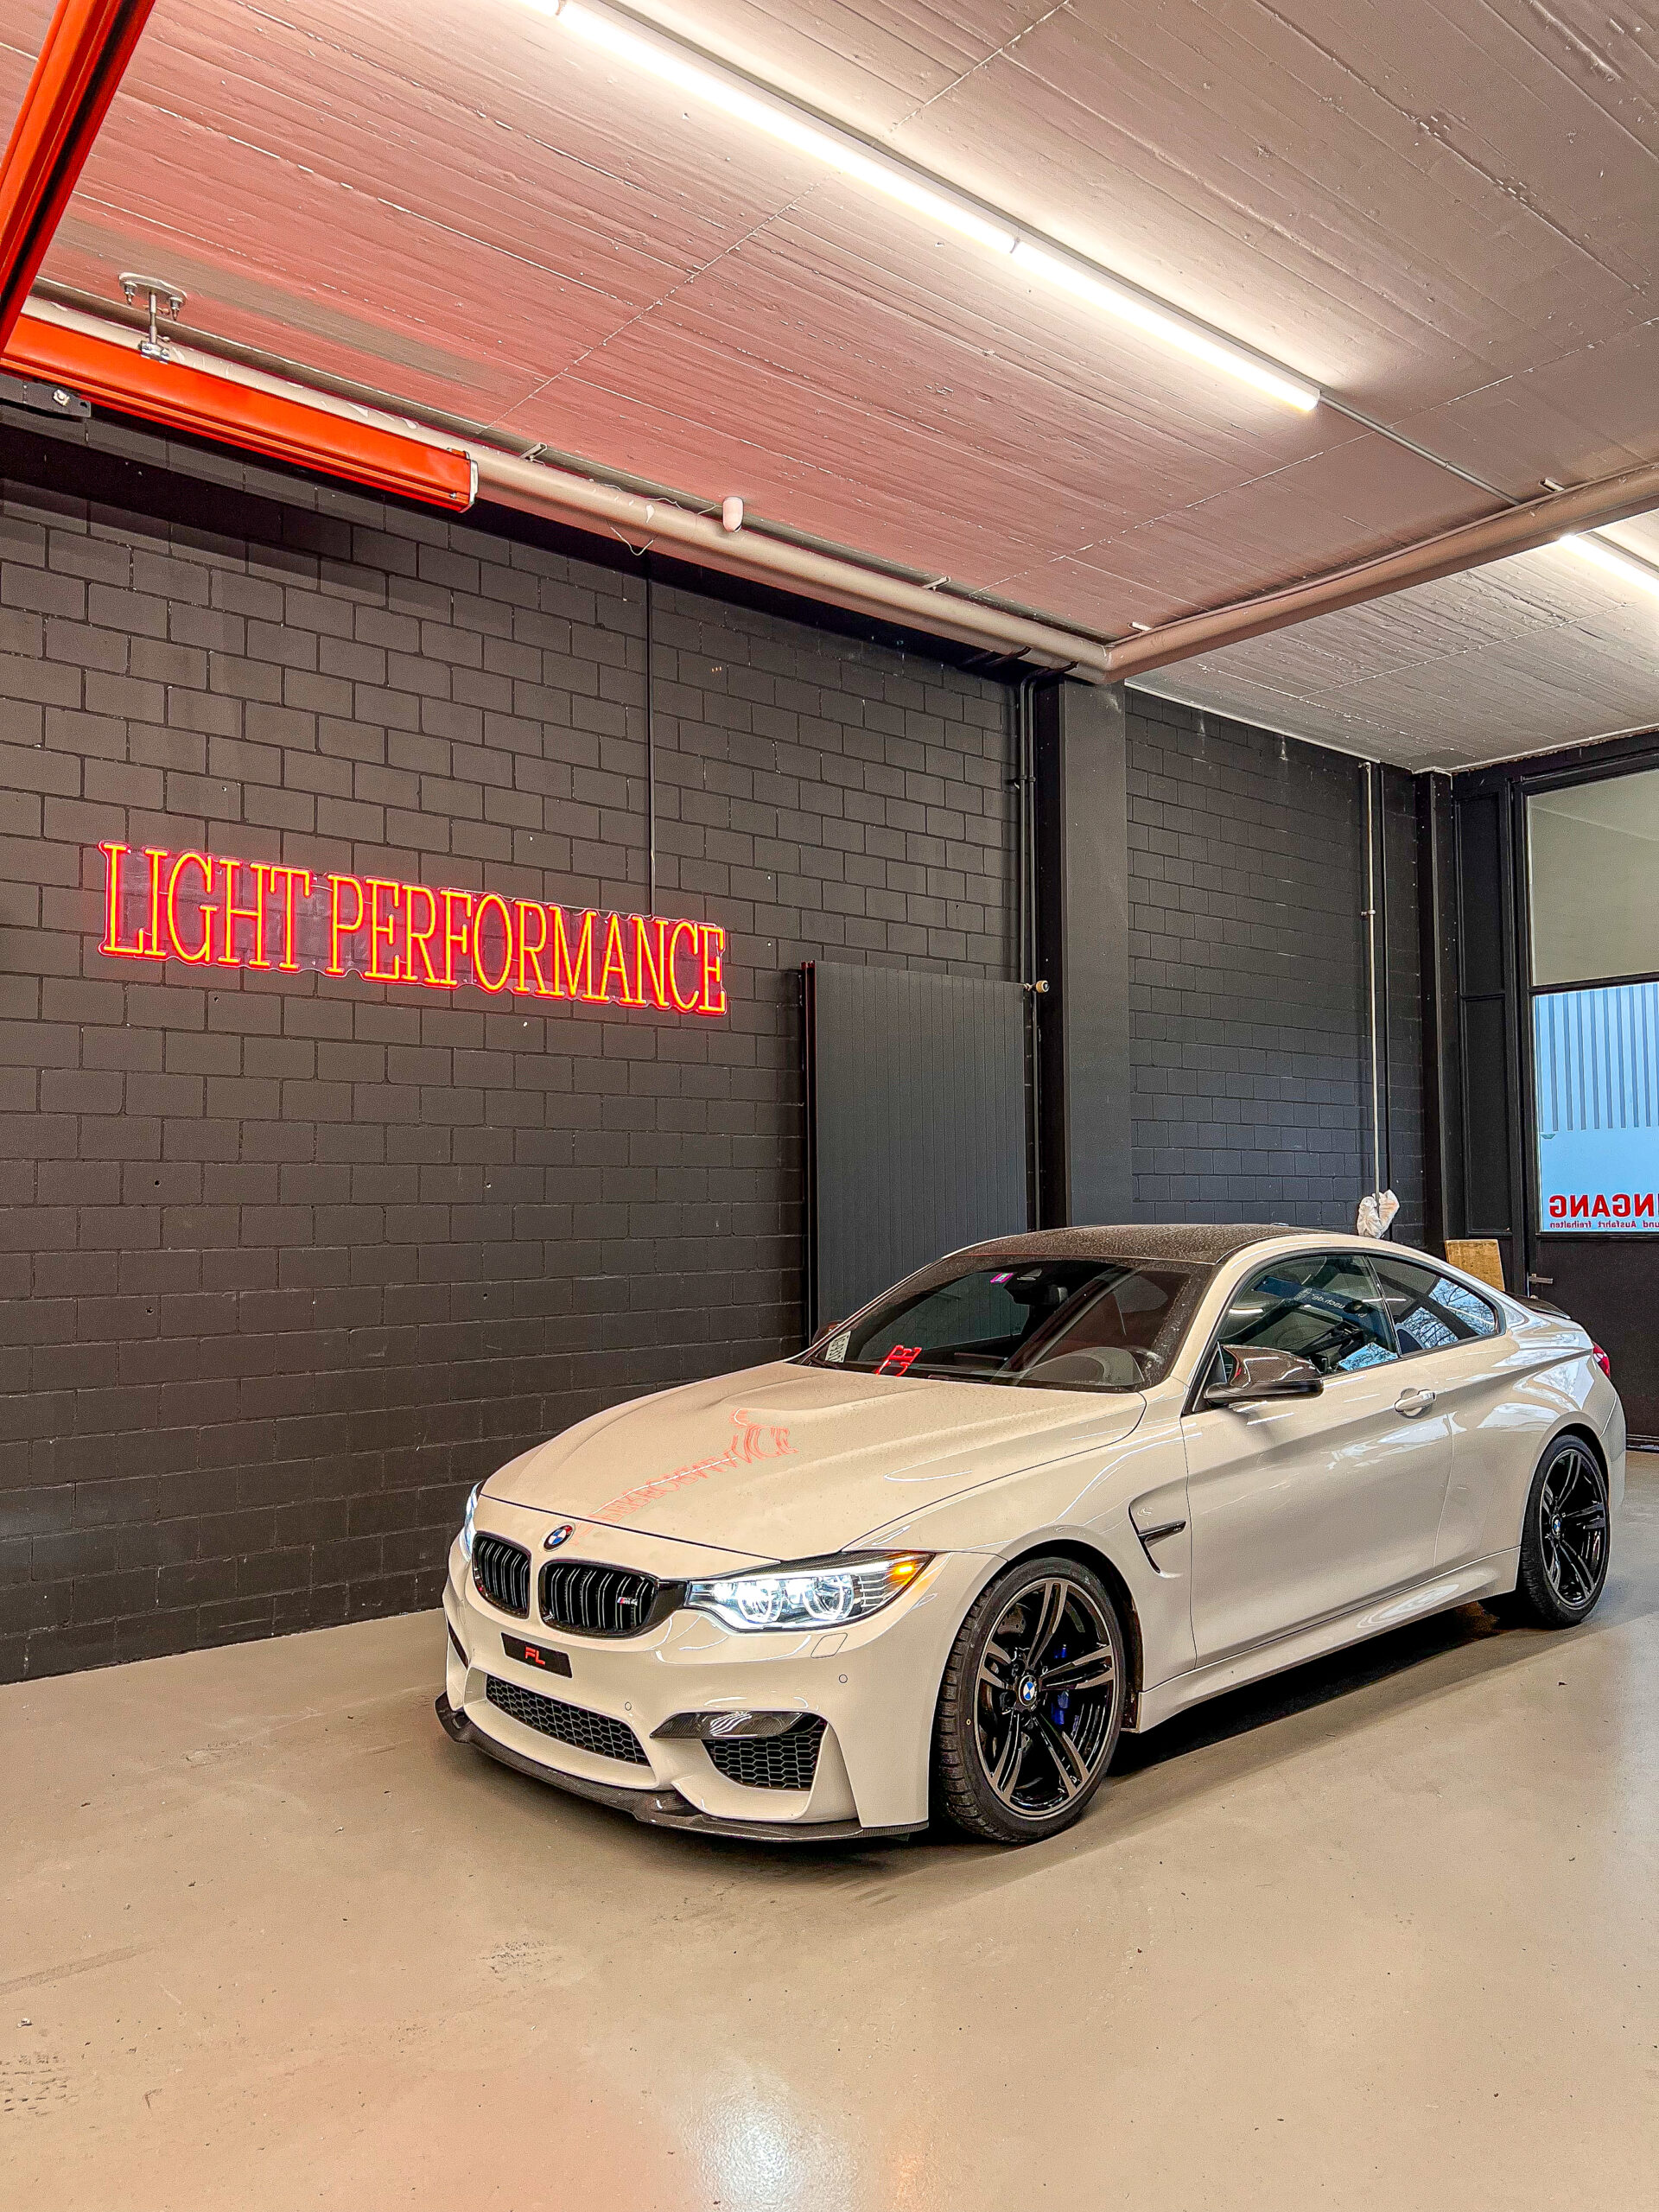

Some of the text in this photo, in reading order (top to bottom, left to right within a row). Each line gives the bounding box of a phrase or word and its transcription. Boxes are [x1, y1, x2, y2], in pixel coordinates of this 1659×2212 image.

[101, 842, 726, 1014] LIGHT PERFORMANCE
[524, 1646, 546, 1666] FL
